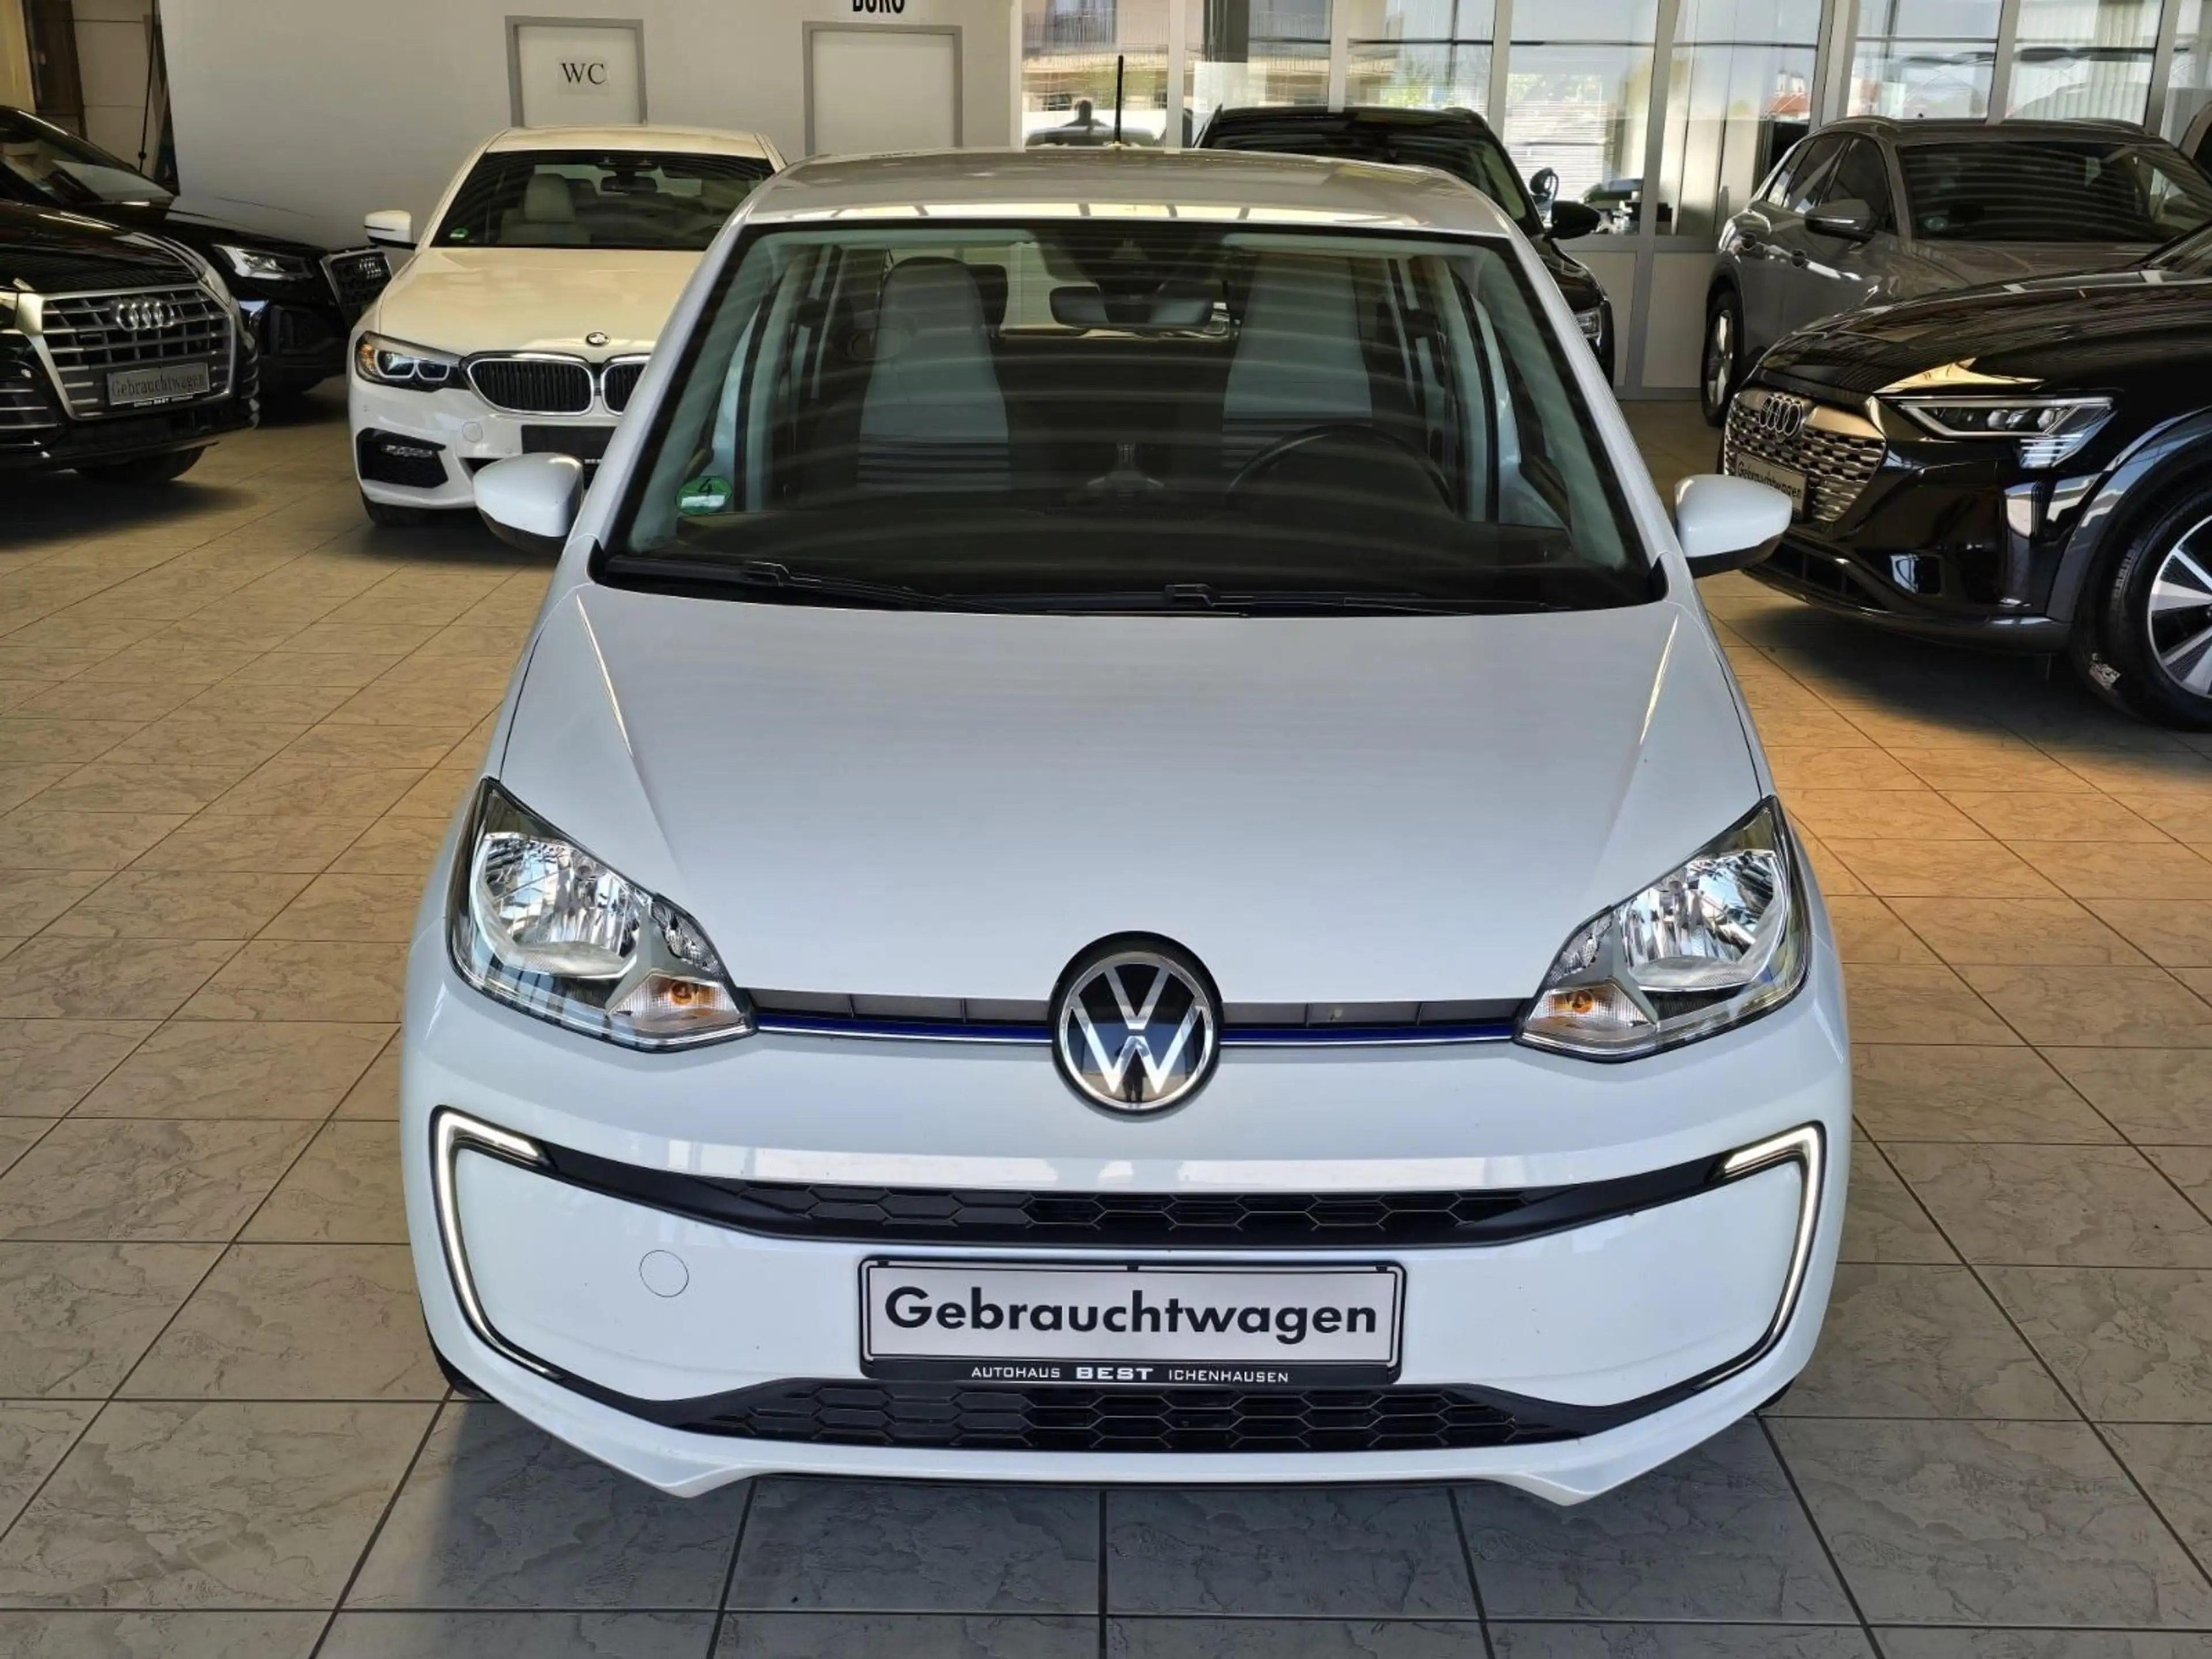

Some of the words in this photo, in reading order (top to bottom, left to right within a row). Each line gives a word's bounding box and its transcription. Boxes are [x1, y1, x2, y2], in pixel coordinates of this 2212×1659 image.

[560, 63, 606, 85] WC
[698, 478, 714, 495] 4
[1063, 956, 1211, 1097] VW
[885, 1286, 1376, 1344] Gebrauchtwagen
[971, 1367, 1060, 1378] AUTOHAUS
[1075, 1367, 1153, 1380] BEST
[1168, 1369, 1289, 1383] ICHENHAUSEN
